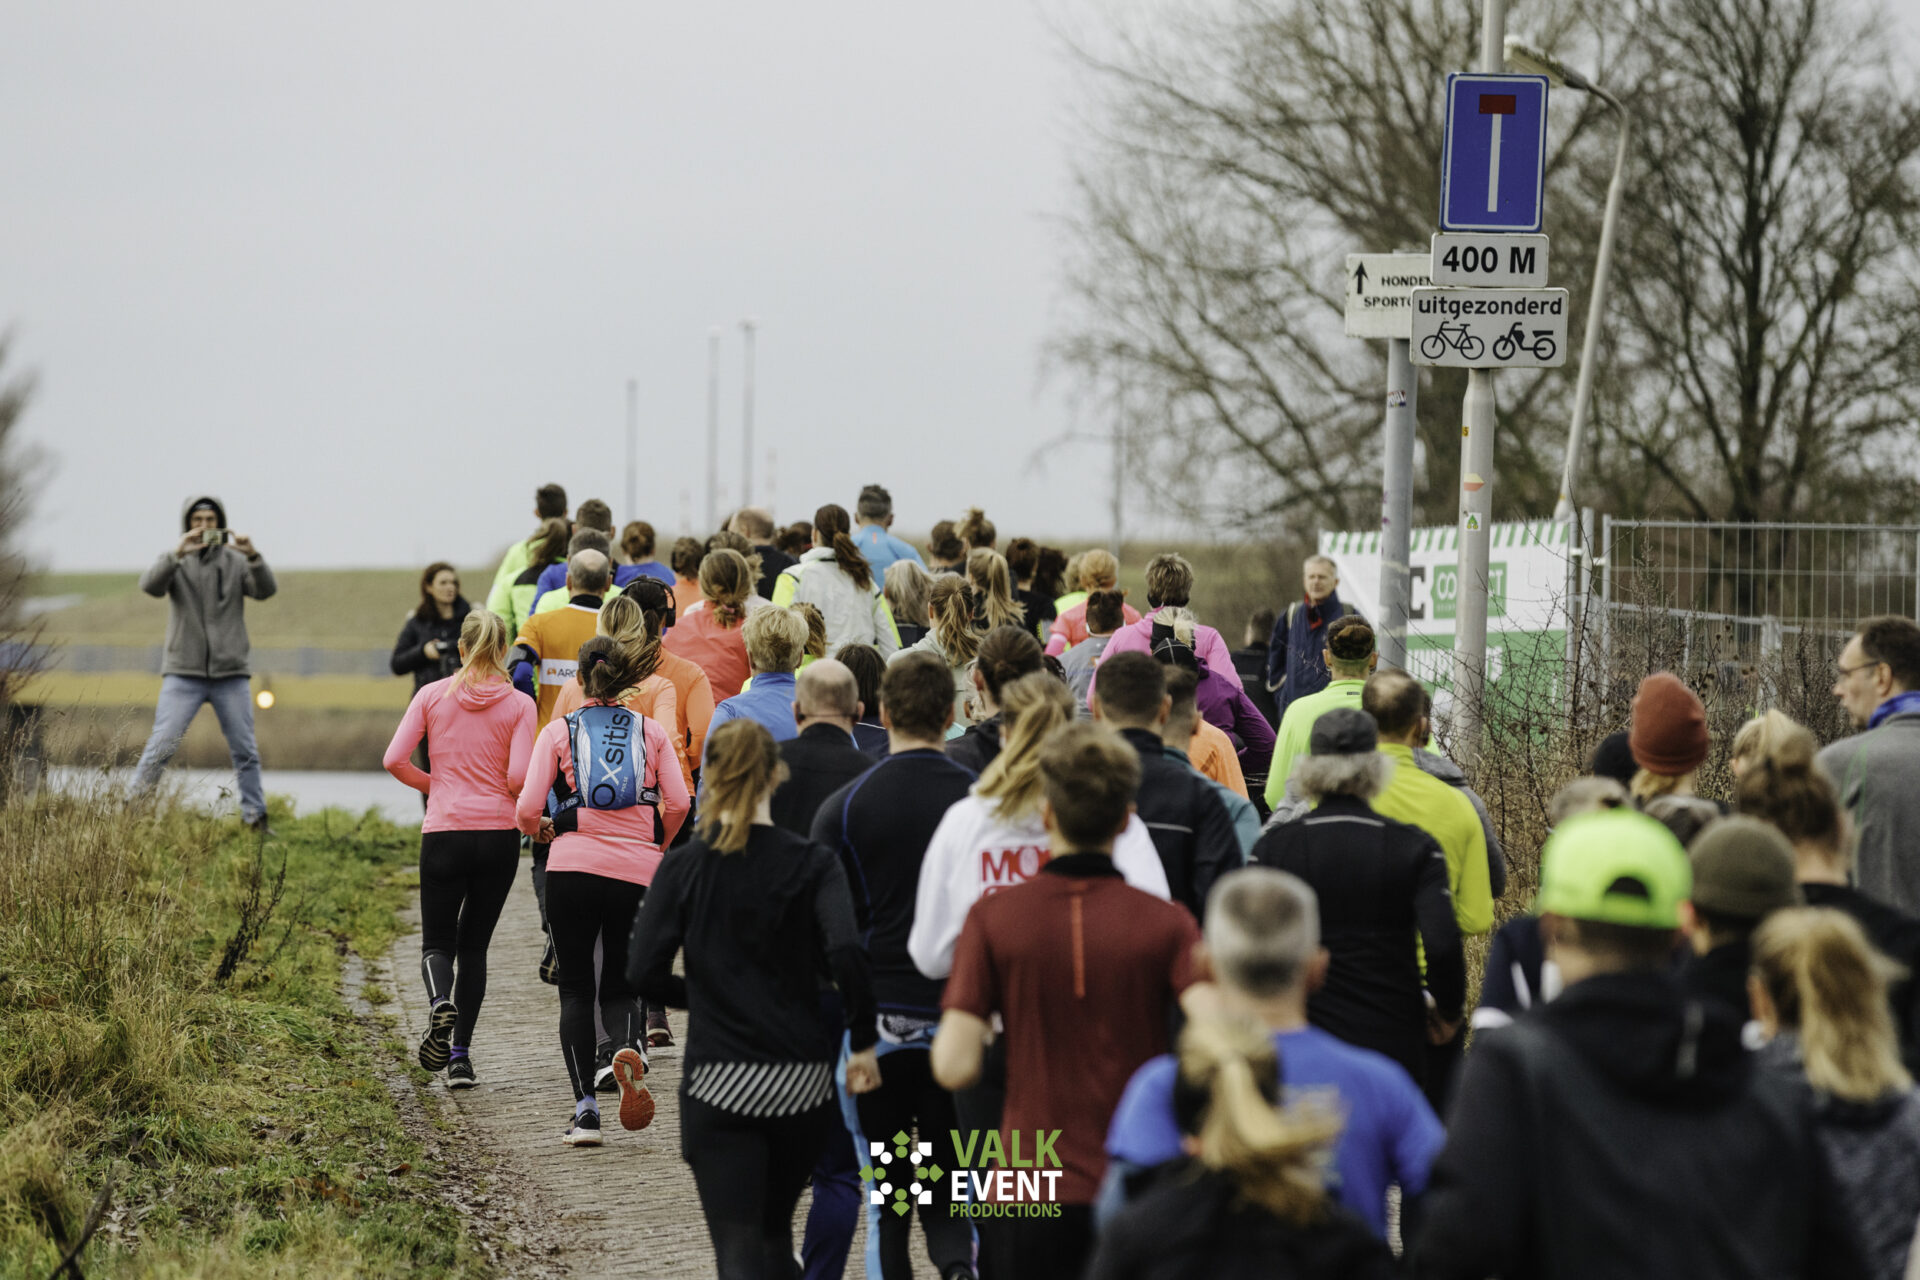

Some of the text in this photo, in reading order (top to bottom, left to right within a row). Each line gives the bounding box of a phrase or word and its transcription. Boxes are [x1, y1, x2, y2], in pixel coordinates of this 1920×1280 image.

[1442, 246, 1536, 274] 400 M
[1418, 296, 1562, 320] uitgezonderd
